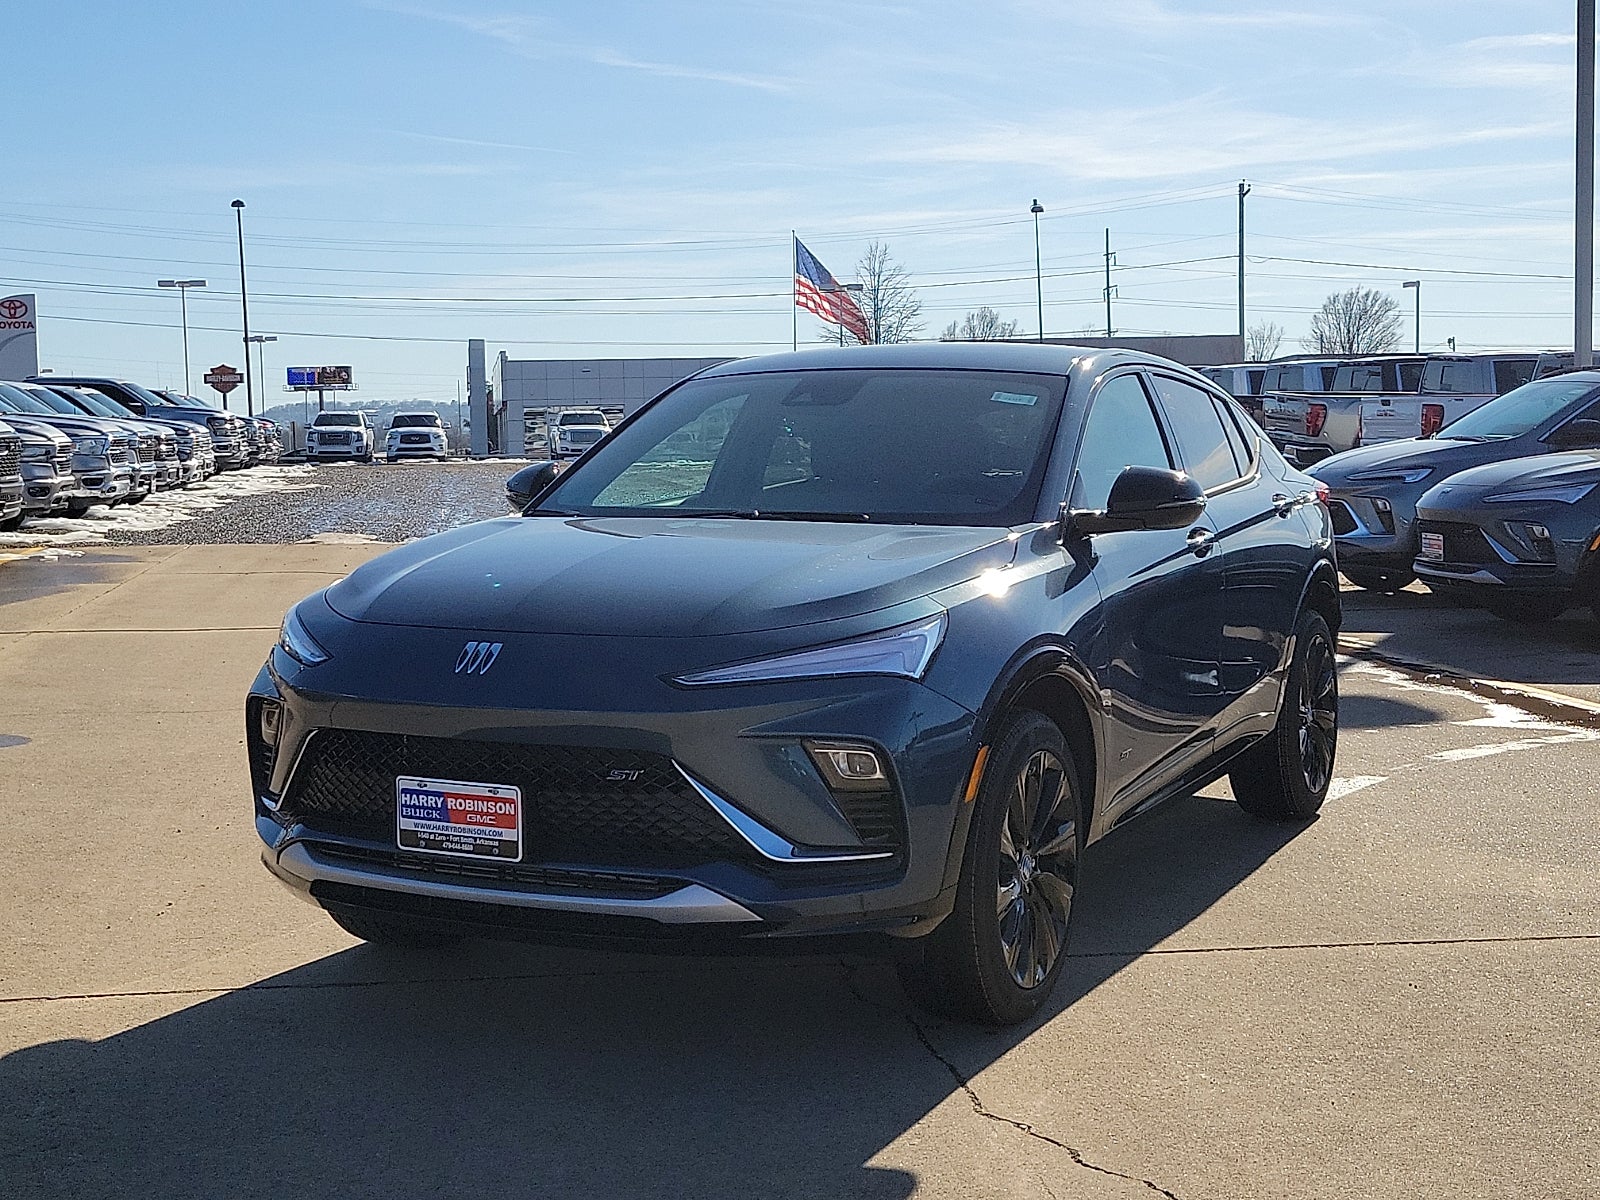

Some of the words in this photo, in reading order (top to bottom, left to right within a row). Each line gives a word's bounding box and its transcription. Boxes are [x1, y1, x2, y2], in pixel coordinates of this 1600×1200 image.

[0, 321, 35, 329] OYOTA
[606, 769, 645, 780] ST
[401, 793, 444, 808] HARRY
[447, 797, 515, 815] ROBINSON
[402, 807, 440, 819] BUICK
[466, 813, 497, 824] GMC
[413, 822, 504, 838] WWW.HARRYROBINSON.COM
